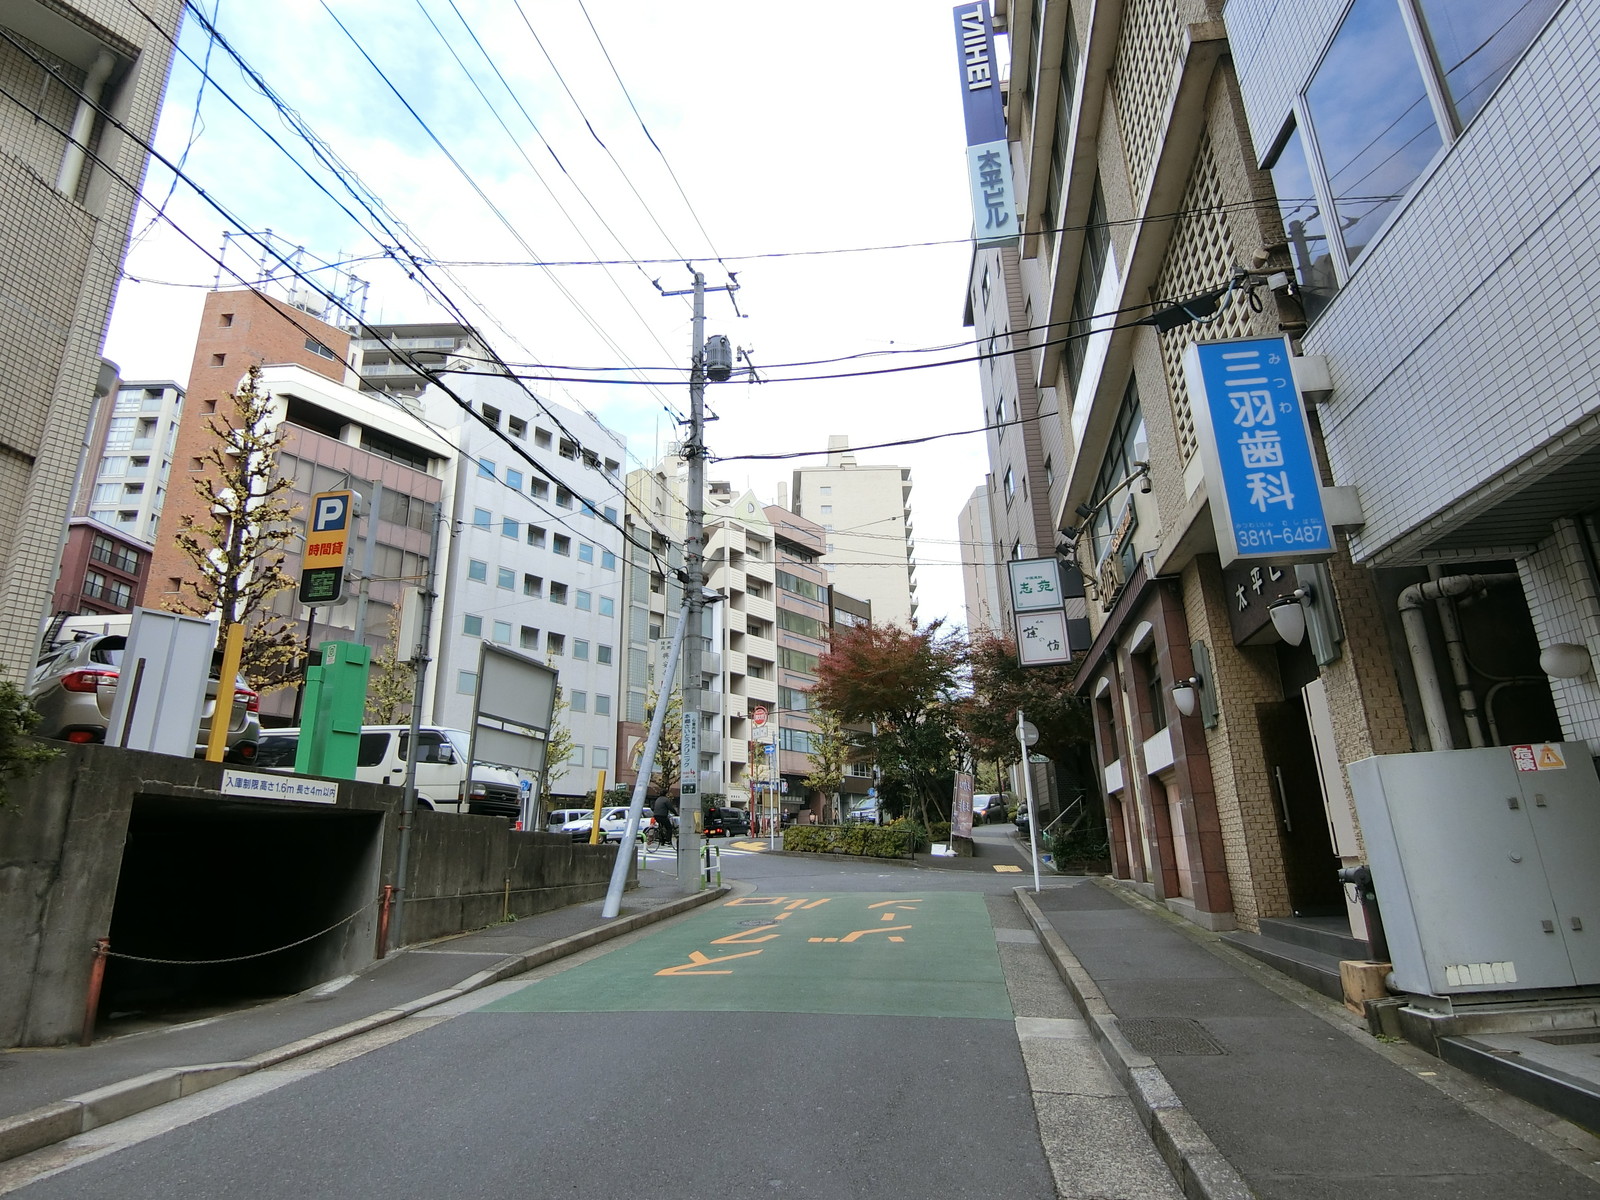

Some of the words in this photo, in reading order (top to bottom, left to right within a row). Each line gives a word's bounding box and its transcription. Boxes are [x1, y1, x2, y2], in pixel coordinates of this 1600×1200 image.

[961, 4, 992, 91] TAIHEI
[977, 149, 1009, 230] 太平ビル
[1268, 353, 1293, 414] みつわ
[1221, 350, 1295, 513] 三羽歯科
[317, 498, 344, 530] P
[308, 542, 344, 557] 時間貸
[1238, 525, 1322, 547] 3811-6487
[308, 570, 336, 598] 空
[1019, 580, 1054, 594] 志苑
[1513, 747, 1537, 770] 危険
[226, 777, 259, 790] 入庫制限
[296, 784, 336, 797] 長さ4m以内
